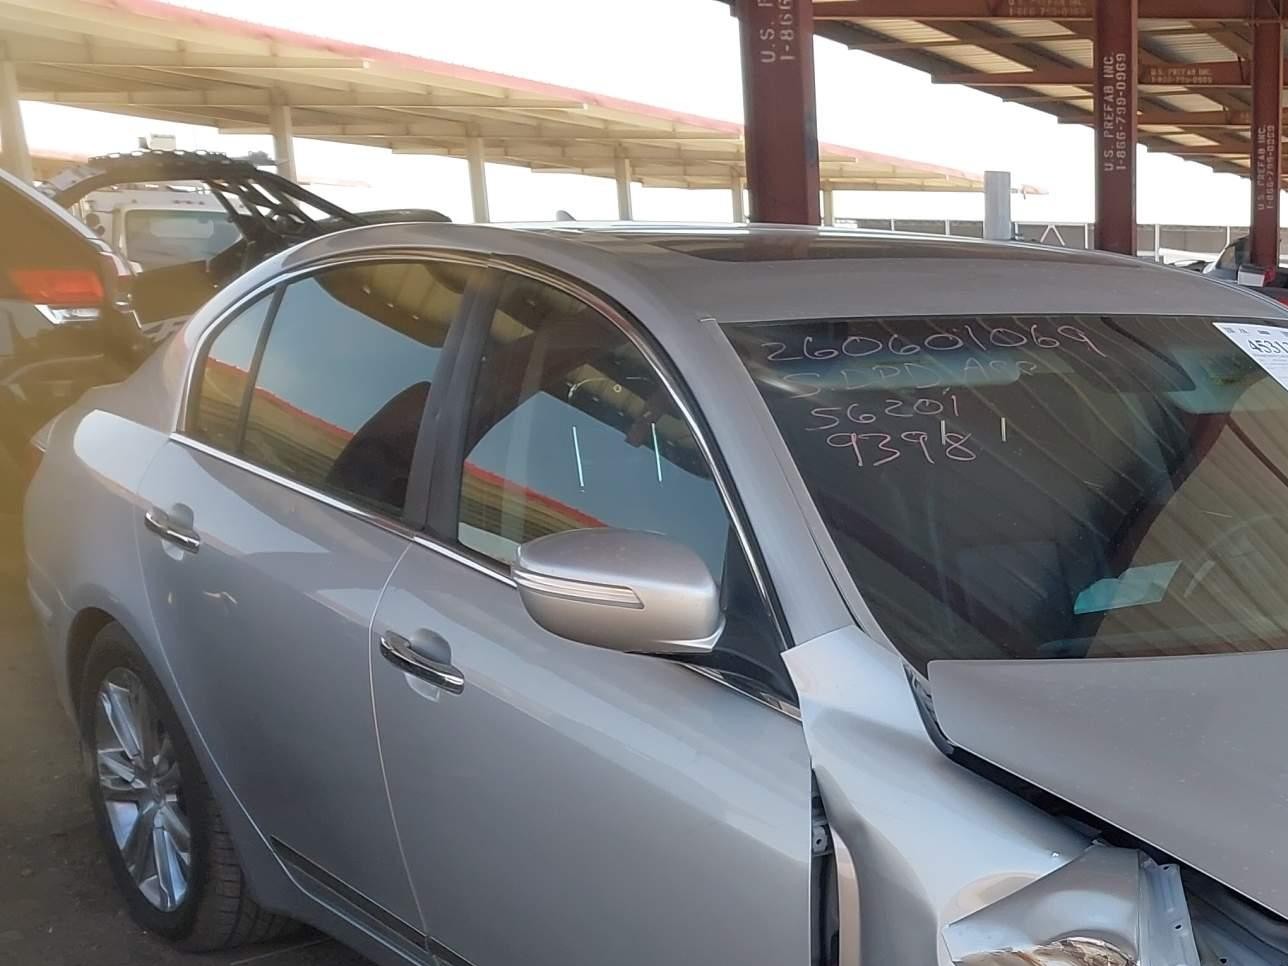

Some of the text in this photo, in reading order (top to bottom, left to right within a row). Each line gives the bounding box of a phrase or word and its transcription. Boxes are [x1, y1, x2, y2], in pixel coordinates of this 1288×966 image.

[1103, 85, 1115, 138] PREFAB
[1115, 52, 1127, 171] 1-866-799-0969
[1103, 144, 1115, 172] U.S.
[760, 323, 1107, 362] 260601069
[825, 430, 977, 467] 9398
